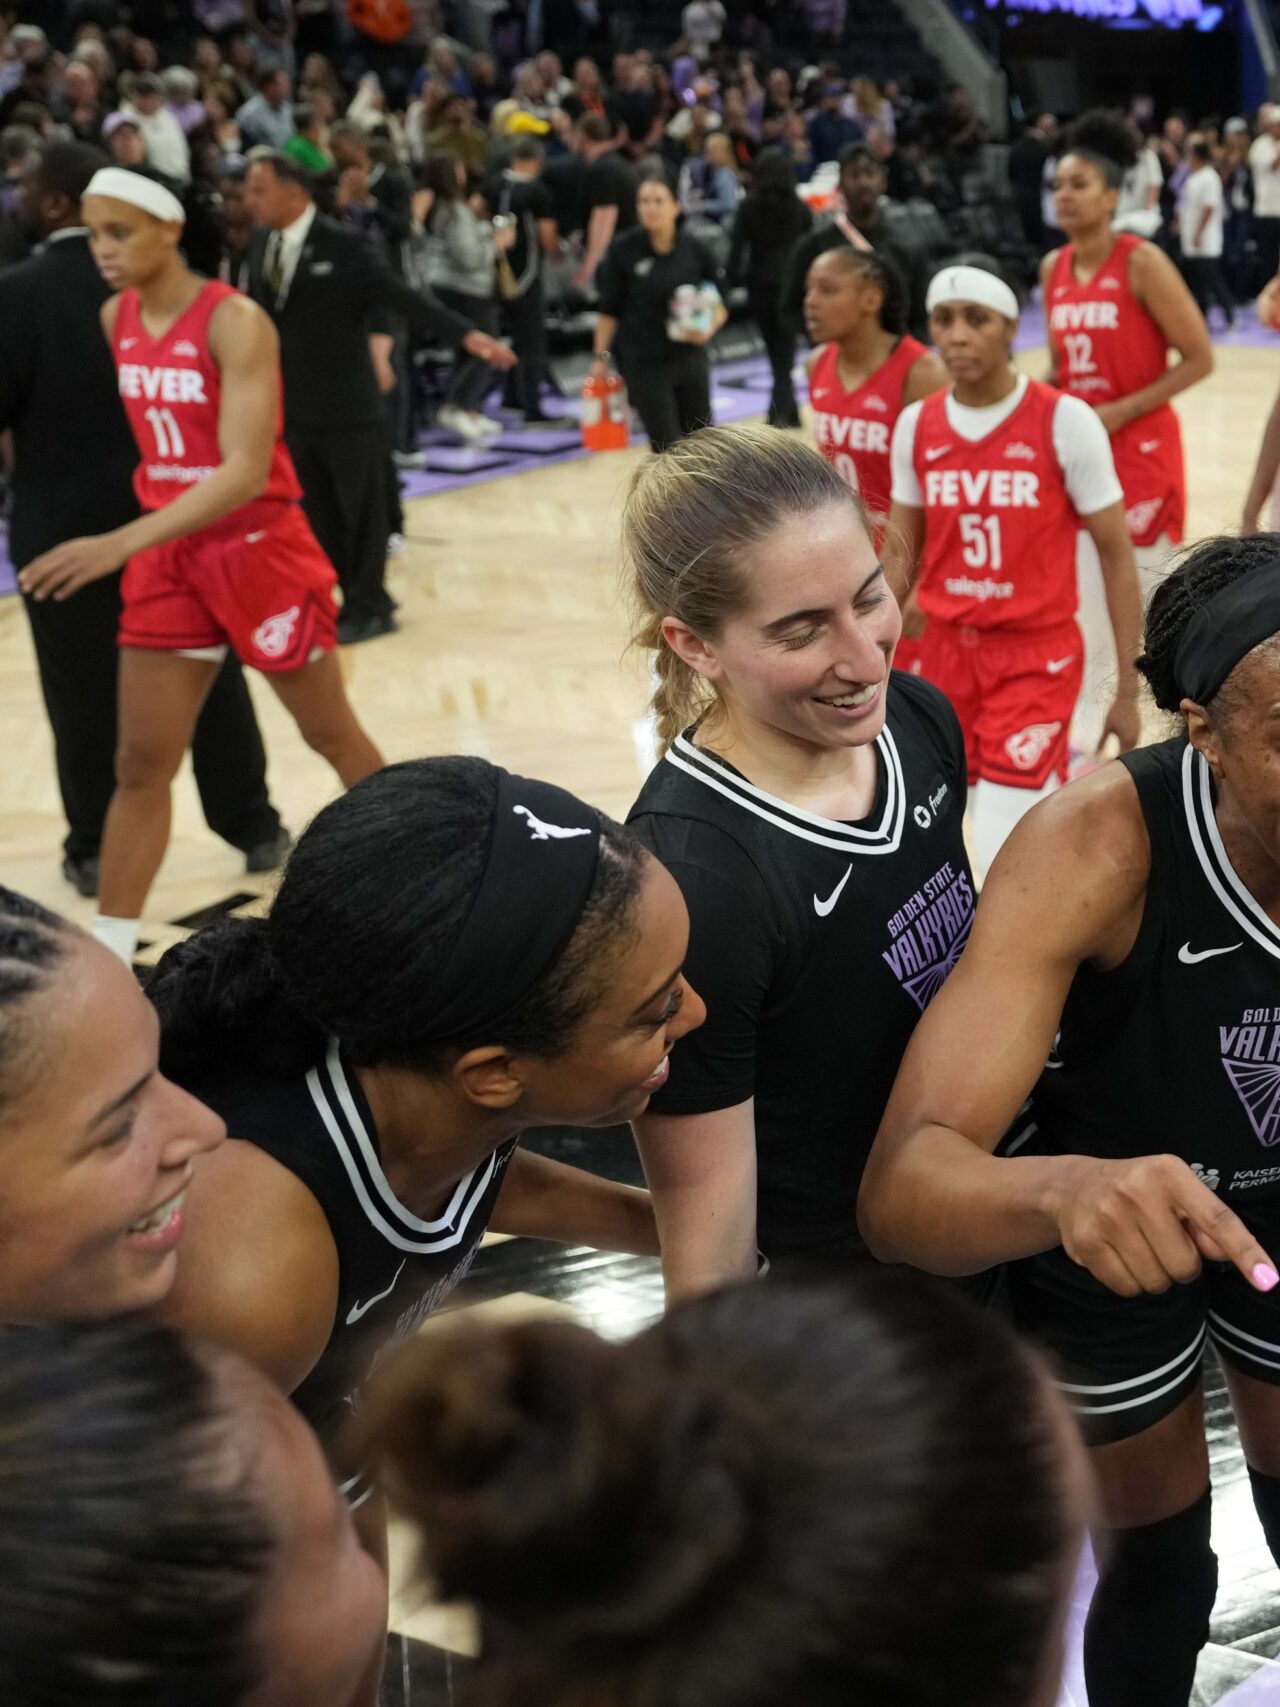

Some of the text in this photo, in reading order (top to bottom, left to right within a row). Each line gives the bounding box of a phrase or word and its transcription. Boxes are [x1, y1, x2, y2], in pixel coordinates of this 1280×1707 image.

[1064, 333, 1096, 371] 12
[145, 406, 185, 457] 11
[816, 412, 889, 453] EVER
[926, 469, 1040, 507] FEVER
[959, 513, 1001, 570] 51
[881, 869, 974, 982] VALKYRIES
[887, 861, 955, 939] GOLDEN STATE
